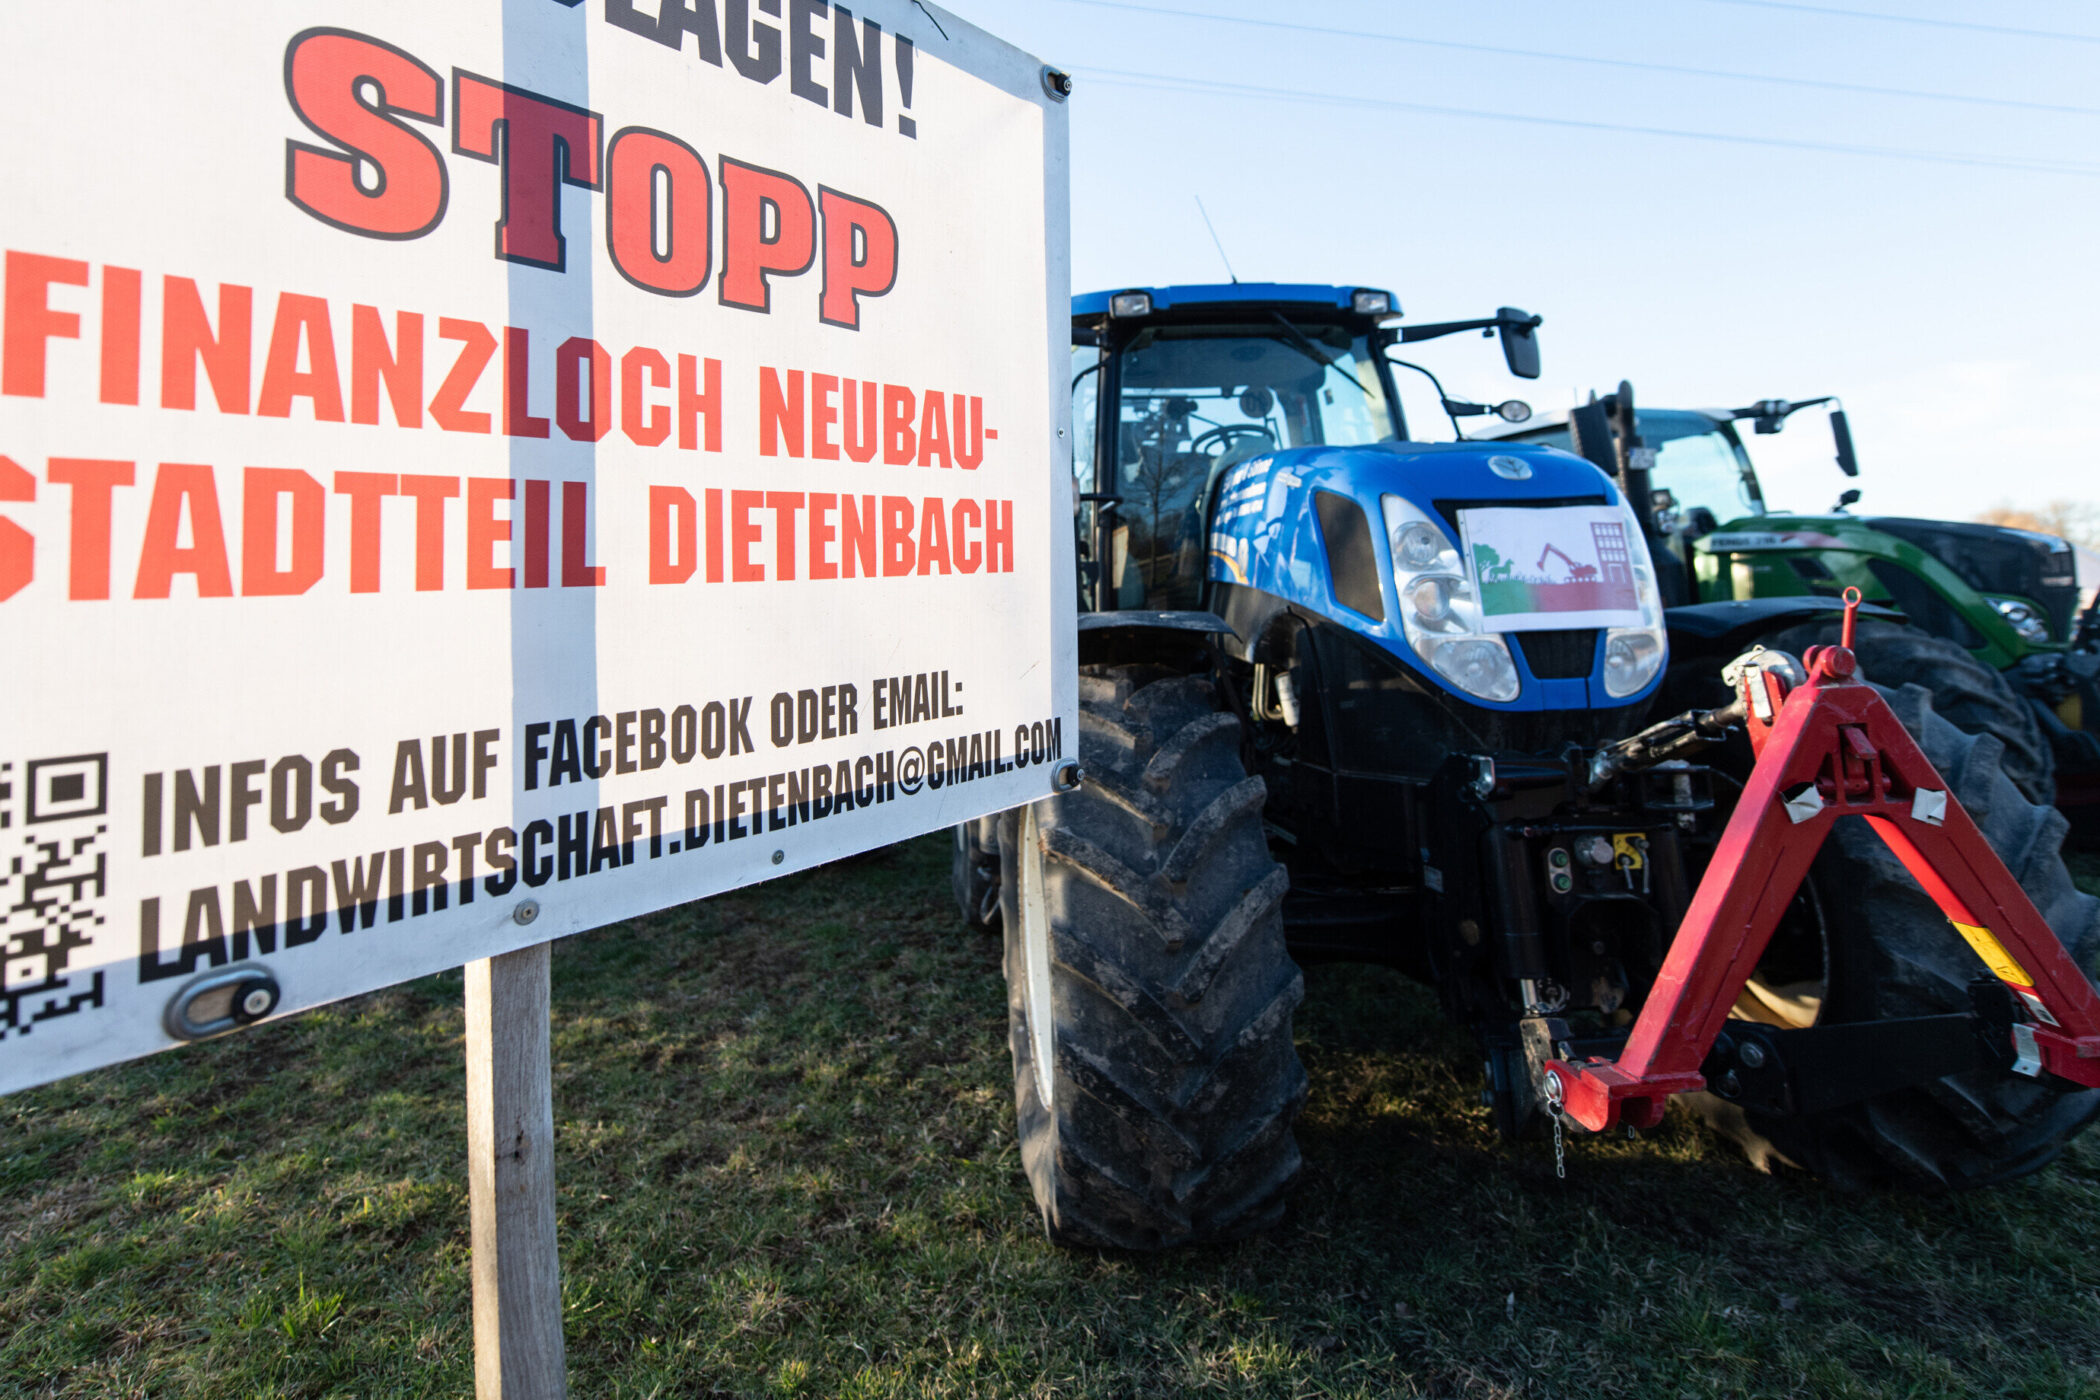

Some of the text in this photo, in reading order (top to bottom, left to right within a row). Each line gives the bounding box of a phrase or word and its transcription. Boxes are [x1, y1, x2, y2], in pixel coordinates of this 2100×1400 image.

[283, 26, 899, 332] STOPP
[2, 249, 999, 471] FINANZLOCH NEUBAU-
[648, 484, 1014, 585] DIETENBACH
[138, 716, 1063, 986] LANDWIRTSCHAFT.DIETENBACH@GMAIL.COM
[141, 669, 964, 859] INFOS AUF FACEBOOK ODER EMAIL:
